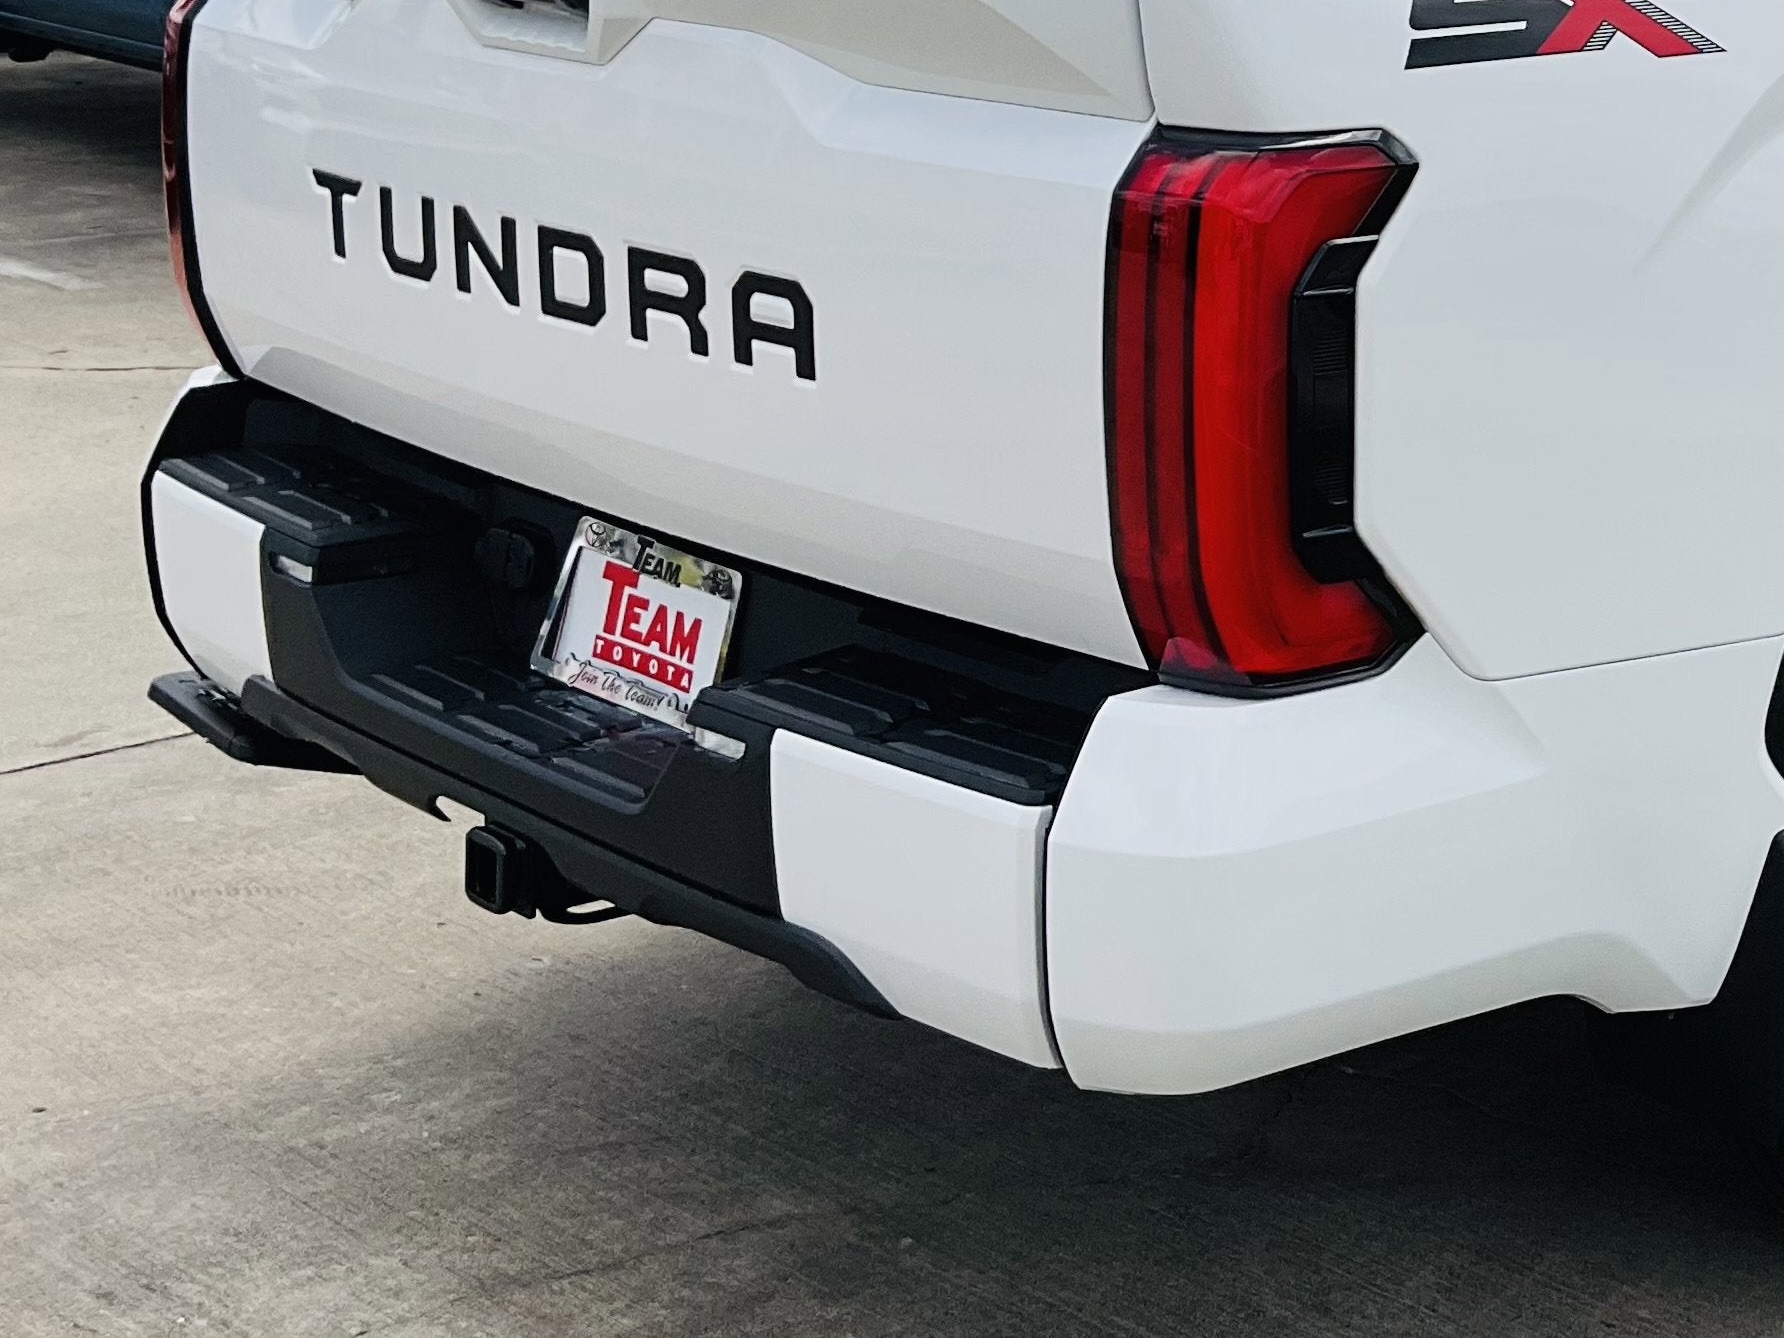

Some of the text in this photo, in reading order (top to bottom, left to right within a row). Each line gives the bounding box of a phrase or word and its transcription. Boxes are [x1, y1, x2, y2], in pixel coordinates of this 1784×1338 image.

[311, 167, 817, 382] TUNDRA
[595, 639, 690, 688] TOYOTA
[602, 560, 703, 664] TEAM
